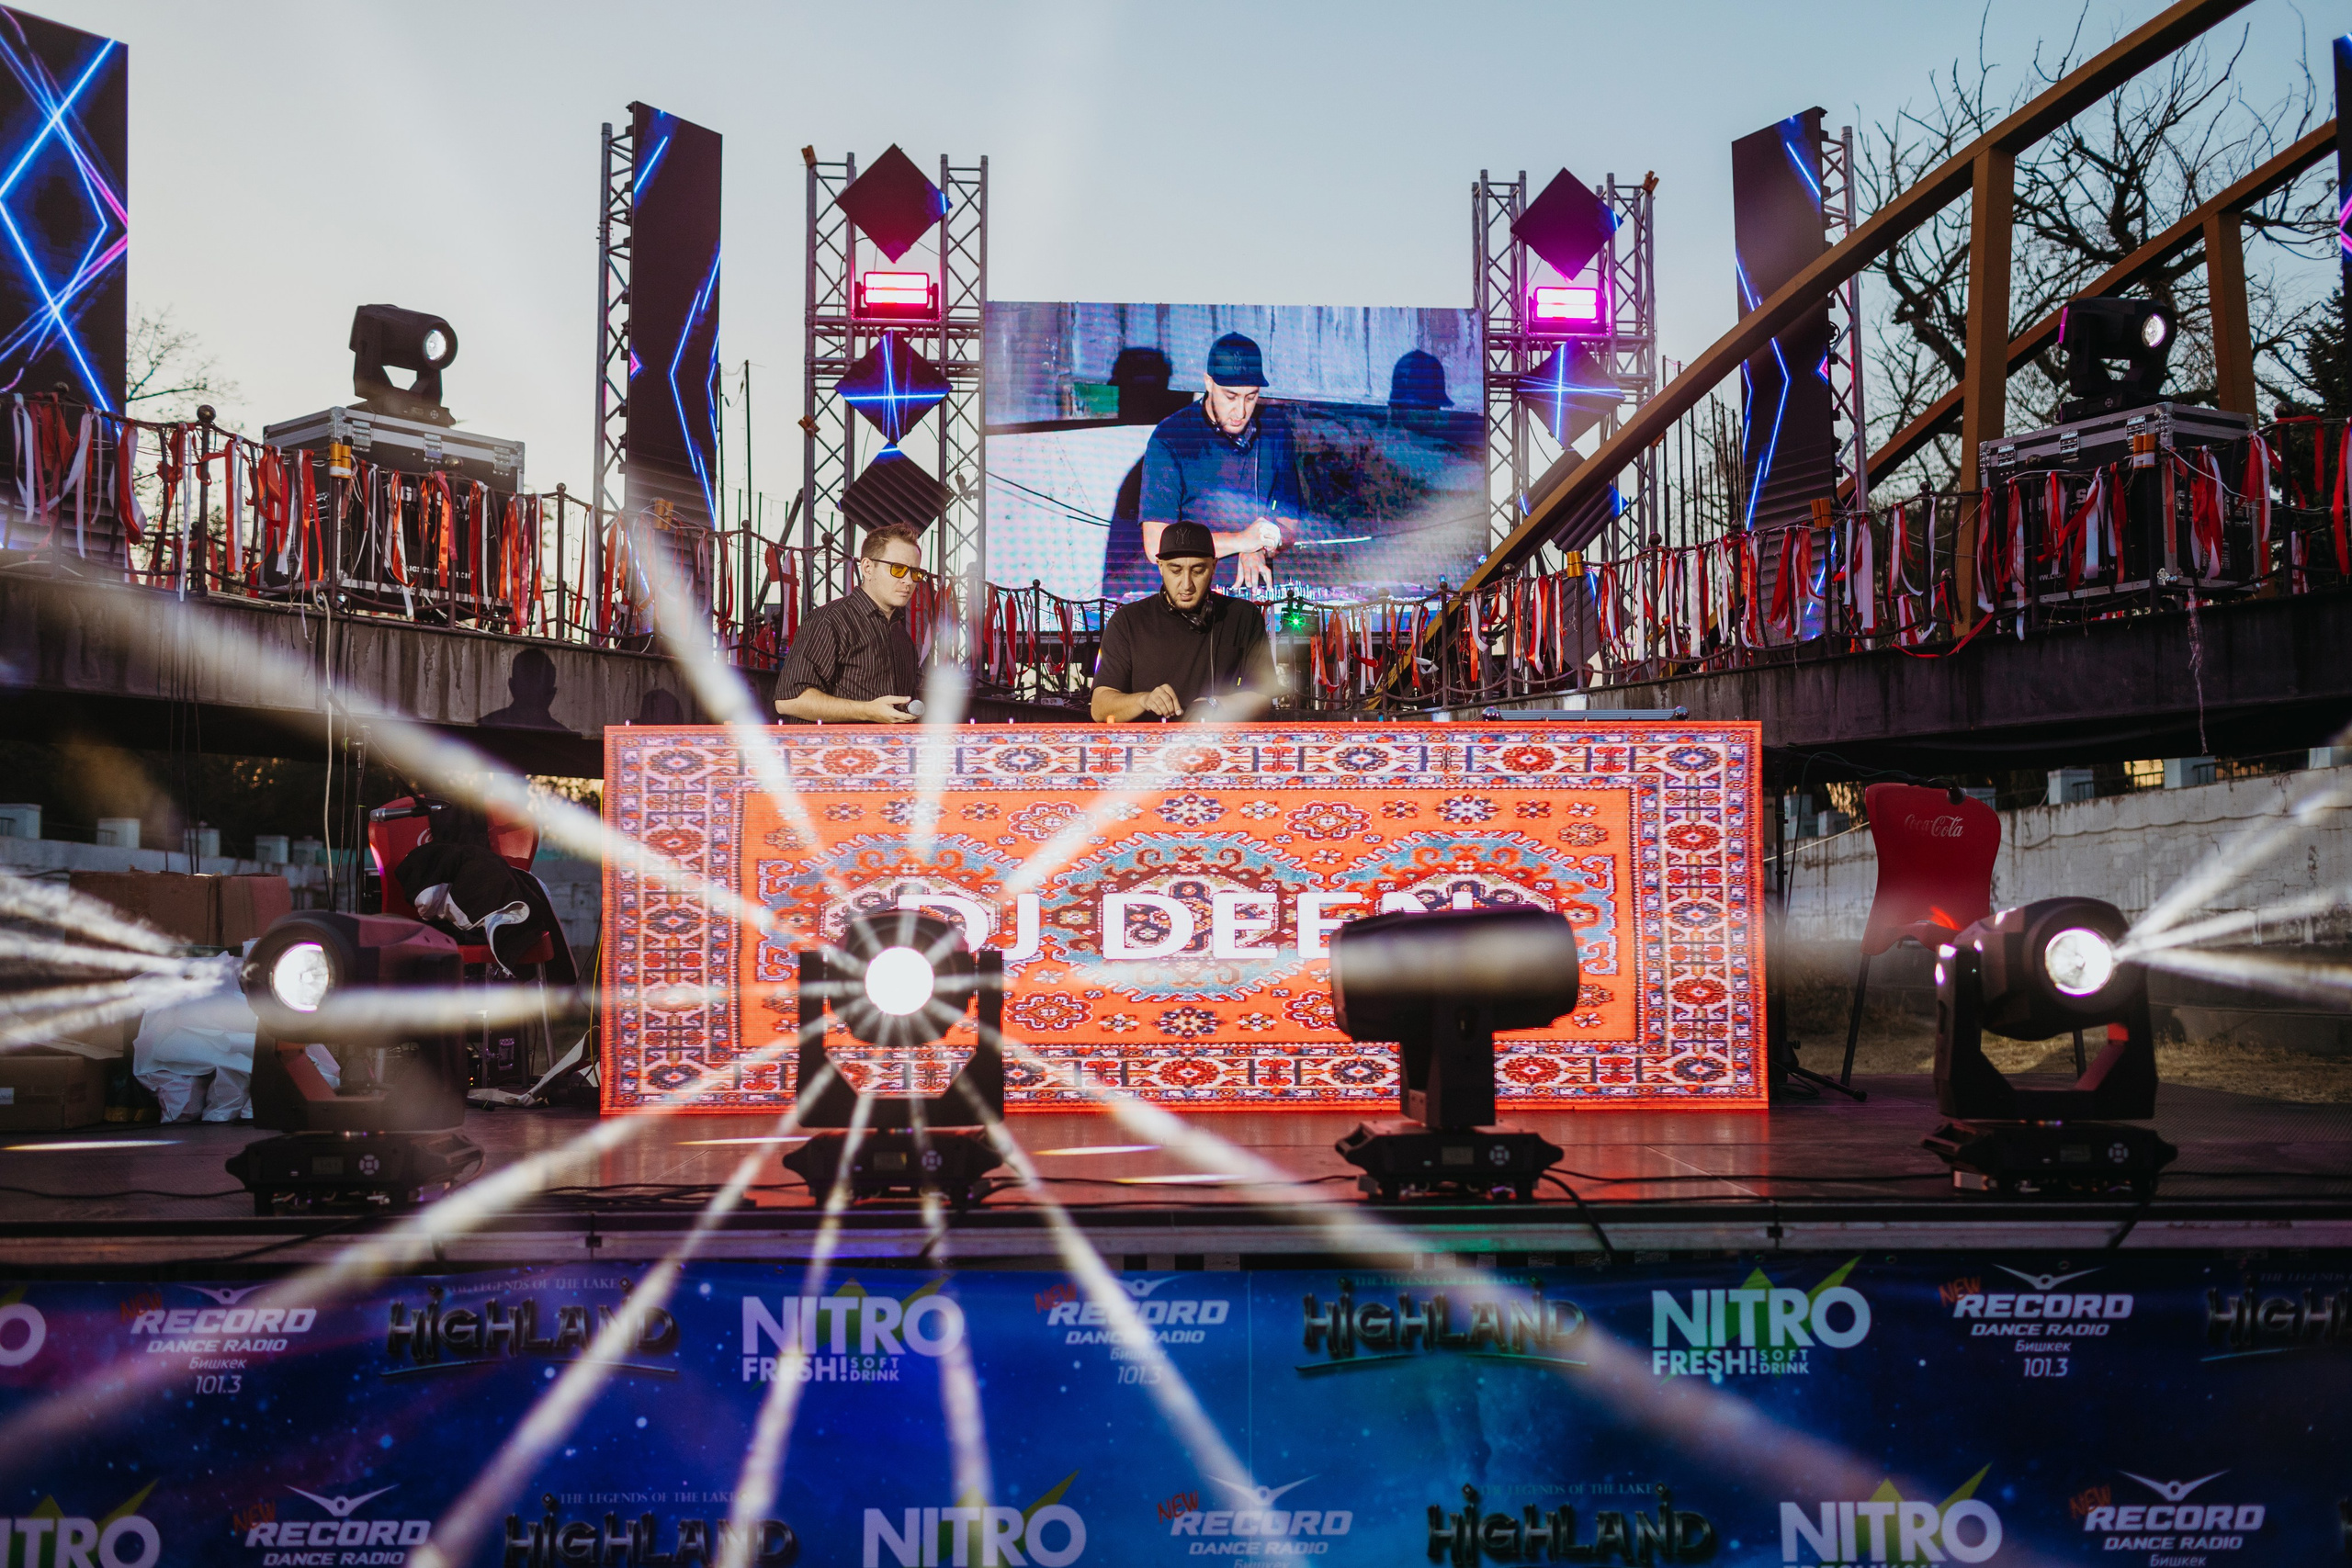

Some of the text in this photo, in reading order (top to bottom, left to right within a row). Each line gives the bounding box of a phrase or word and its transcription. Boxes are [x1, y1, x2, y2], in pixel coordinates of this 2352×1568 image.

[1102, 891, 1474, 960] DEE
[1046, 1300, 1231, 1325] REORD
[1952, 1293, 2134, 1318] RECORD
[130, 1308, 317, 1334] RECORD
[741, 1294, 965, 1357] NITRO
[1651, 1286, 1871, 1348] NITRO
[1065, 1331, 1139, 1345] DANC
[1970, 1323, 2110, 1337] DANCE RADIO
[146, 1338, 288, 1353] DANCE RADIO
[1759, 1349, 1809, 1361] SOFT
[2014, 1339, 2072, 1352] Бишкек
[189, 1356, 248, 1370] Бишкек
[741, 1356, 847, 1382] FRSH!
[850, 1357, 899, 1369] SOFT
[1652, 1348, 1757, 1375] FRESH!
[1759, 1362, 1809, 1374] DRINK
[2023, 1357, 2069, 1377] 101.3
[196, 1375, 243, 1394] 101.3
[850, 1370, 899, 1382] DRINK
[560, 1493, 583, 1504] THE
[589, 1492, 648, 1504] LEGENDS
[651, 1492, 666, 1503] OF
[674, 1492, 698, 1502] THE
[1591, 1484, 1613, 1495] THE
[1619, 1483, 1652, 1495] LAKE
[1170, 1510, 1353, 1536] RECORD
[2083, 1504, 2266, 1531] RECORD
[244, 1520, 431, 1547] RECORD
[863, 1504, 1087, 1568] NITRO
[1426, 1502, 1715, 1568] HIGHLAND
[1780, 1499, 2003, 1563] NITRO
[1189, 1541, 1329, 1555] DANCE RADIO
[2103, 1536, 2244, 1551] DANCE RADIO
[263, 1551, 404, 1566] DANCE RADIO
[2150, 1553, 2207, 1567] Бишкек
